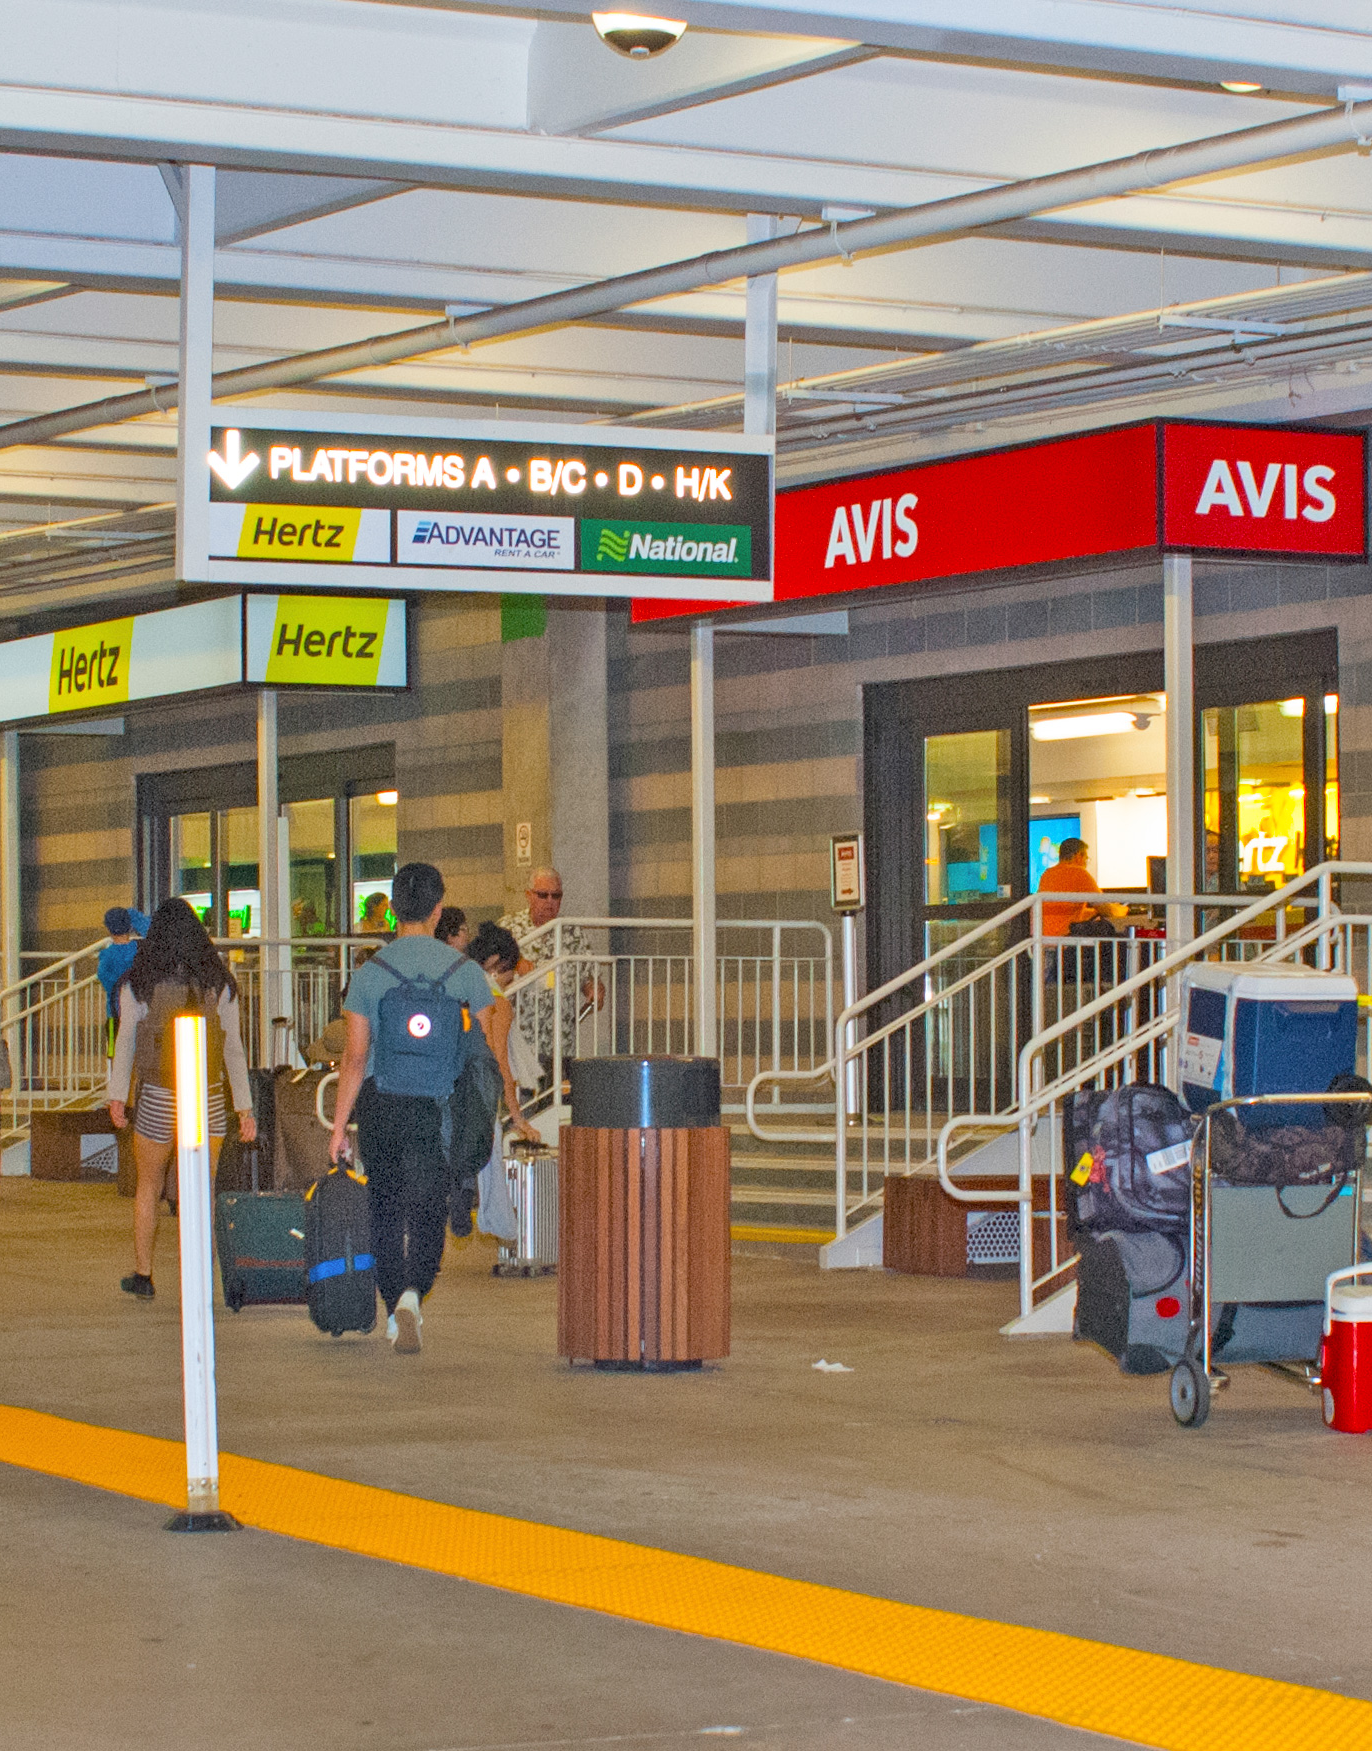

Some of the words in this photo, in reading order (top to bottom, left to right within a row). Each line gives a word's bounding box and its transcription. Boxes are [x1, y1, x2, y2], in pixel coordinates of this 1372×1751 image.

[269, 446, 464, 488] PLATFORMS
[471, 457, 496, 489] A
[529, 459, 587, 495] B/C
[618, 464, 643, 495] D
[675, 466, 732, 501] H/K
[1195, 459, 1337, 523] AVIS
[253, 516, 344, 548] Hertz
[428, 520, 561, 550] ADVANTAGE
[629, 533, 735, 564] National
[824, 493, 919, 568] AVIS
[494, 548, 521, 557] RENT
[523, 549, 531, 558] A
[534, 549, 555, 559] CAR
[276, 623, 378, 659] Hertz
[58, 640, 121, 696] Hertz
[1239, 831, 1289, 872] rtz
